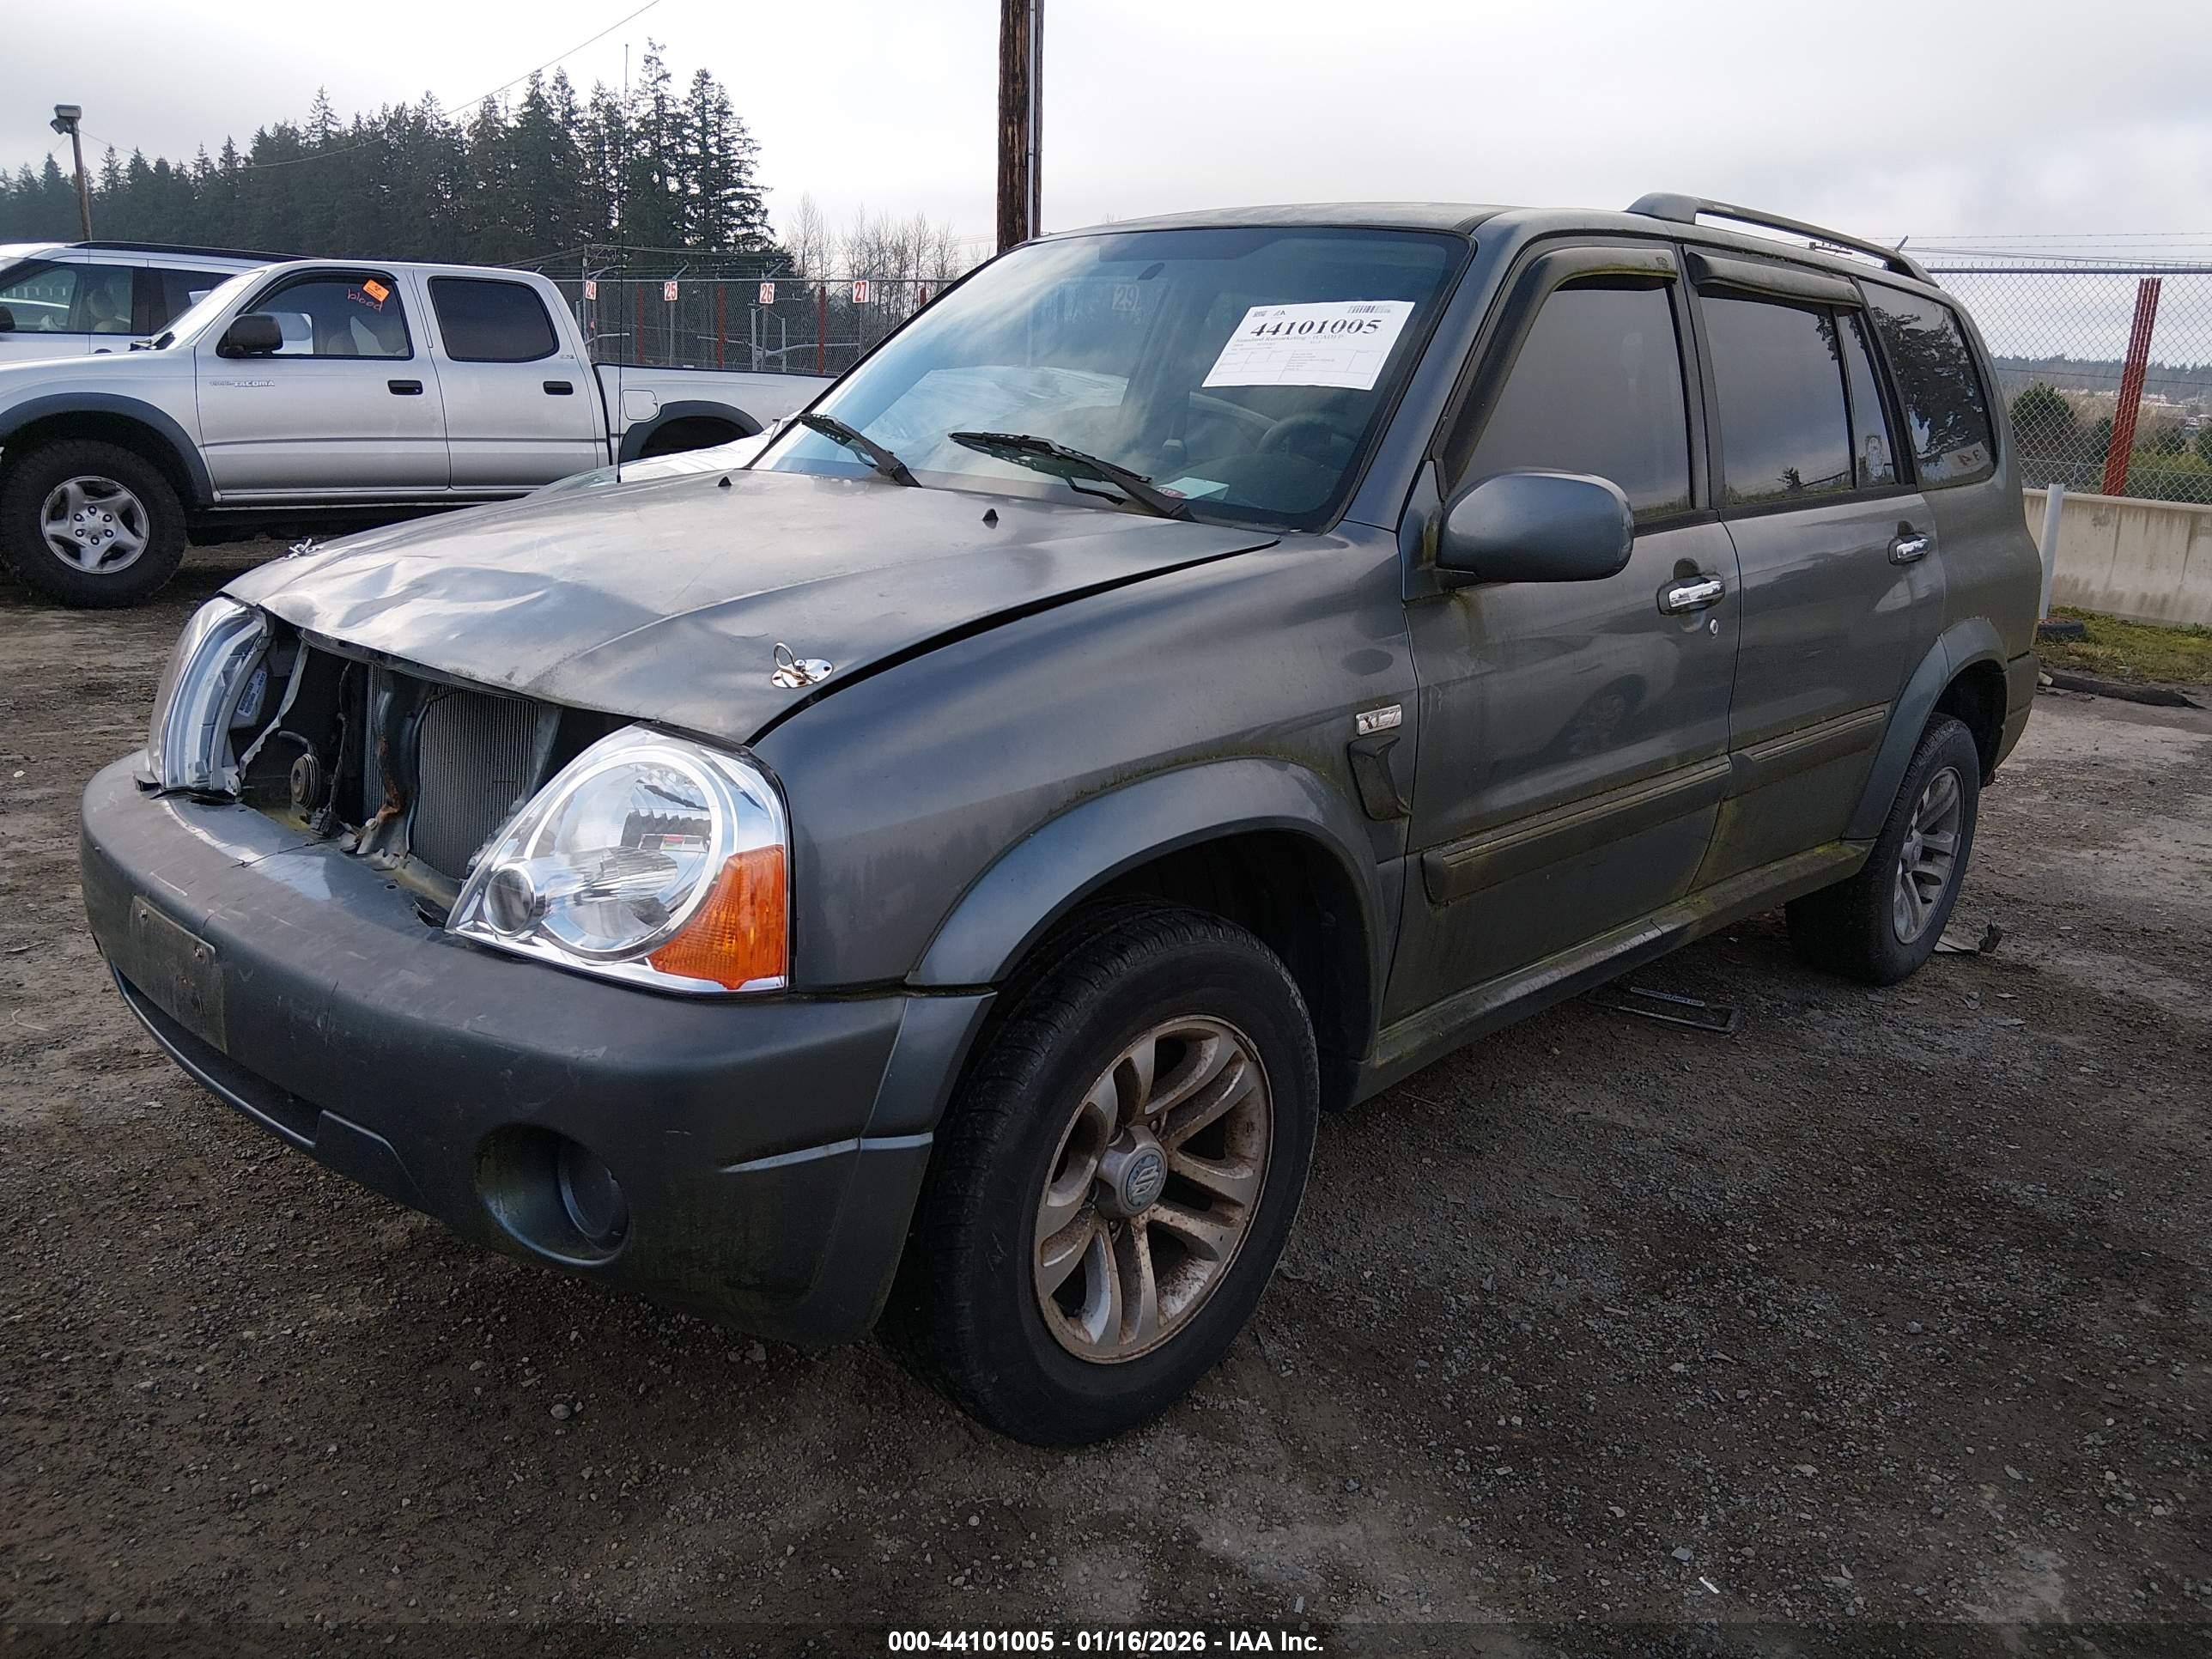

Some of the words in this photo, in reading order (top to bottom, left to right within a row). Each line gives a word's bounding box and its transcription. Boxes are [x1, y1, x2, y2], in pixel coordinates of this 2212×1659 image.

[586, 282, 595, 299] 24
[665, 283, 677, 300] 25
[761, 284, 773, 302] 26
[854, 281, 867, 302] 27
[1250, 319, 1382, 337] 44101005
